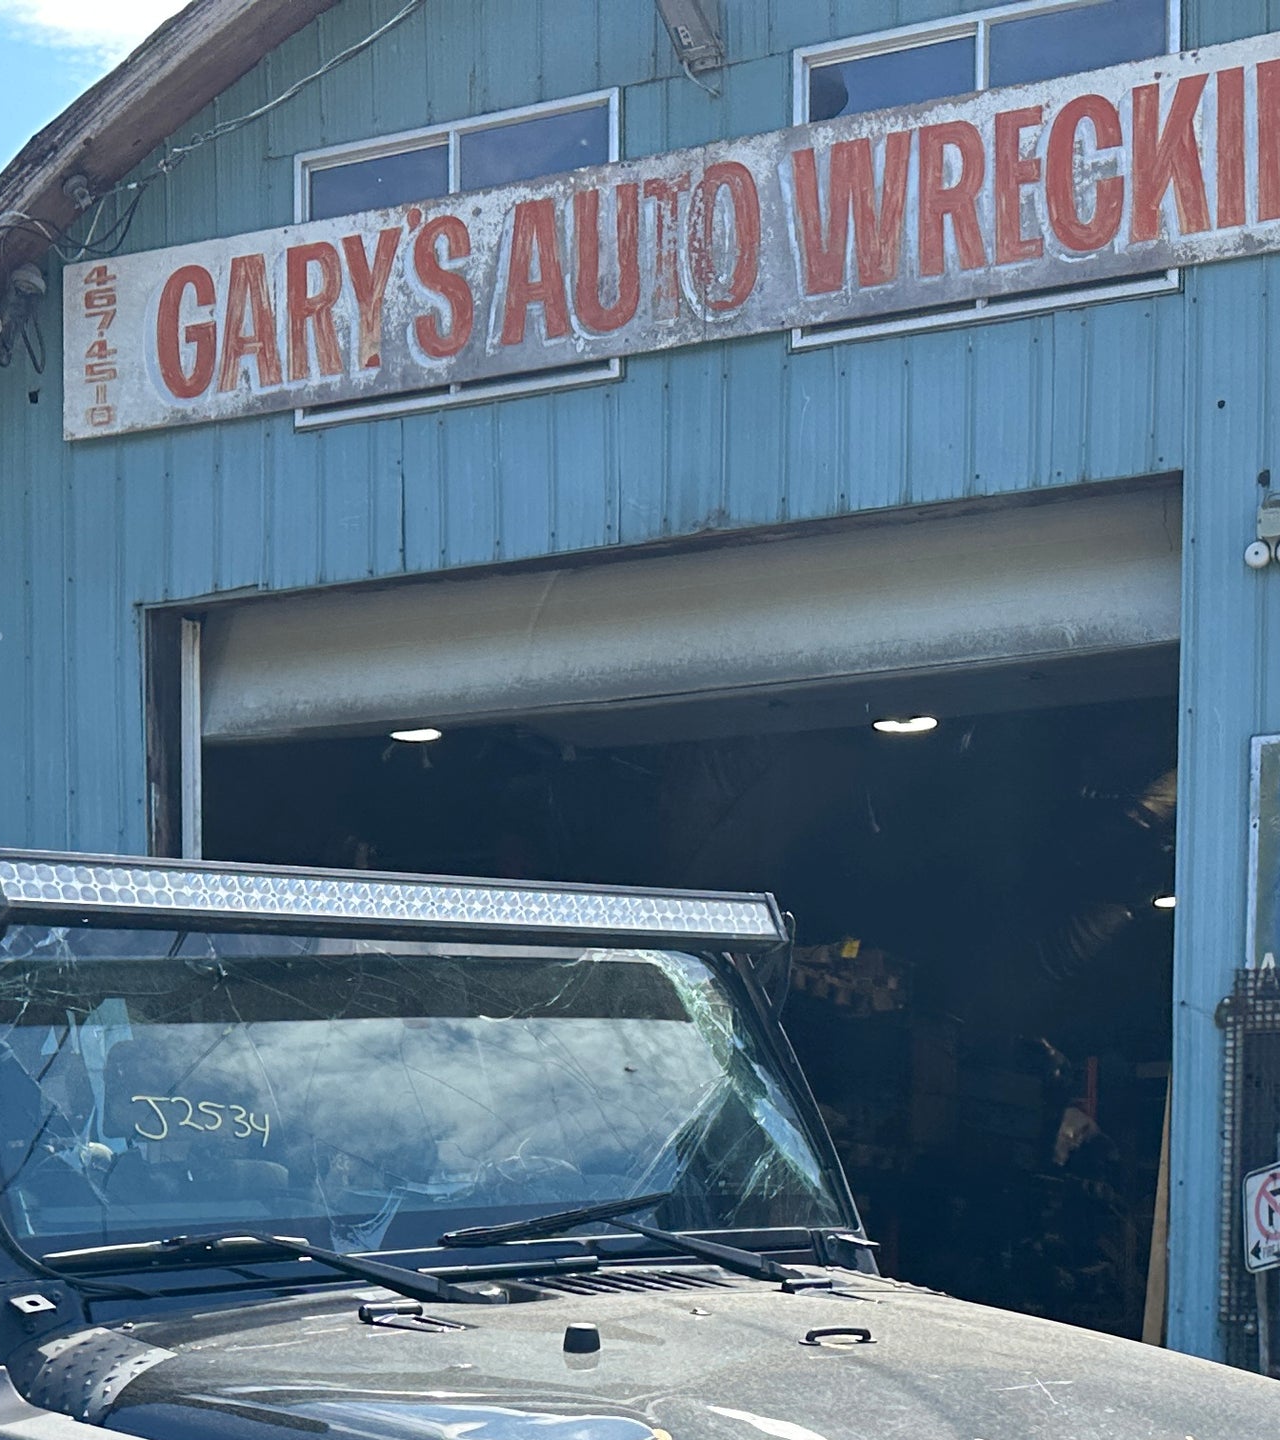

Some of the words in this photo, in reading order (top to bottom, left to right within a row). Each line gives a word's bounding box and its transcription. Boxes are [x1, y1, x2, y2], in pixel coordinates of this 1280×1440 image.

[156, 207, 472, 398] GARY'S
[500, 161, 761, 346] AUTO
[131, 1095, 269, 1147] J2534
